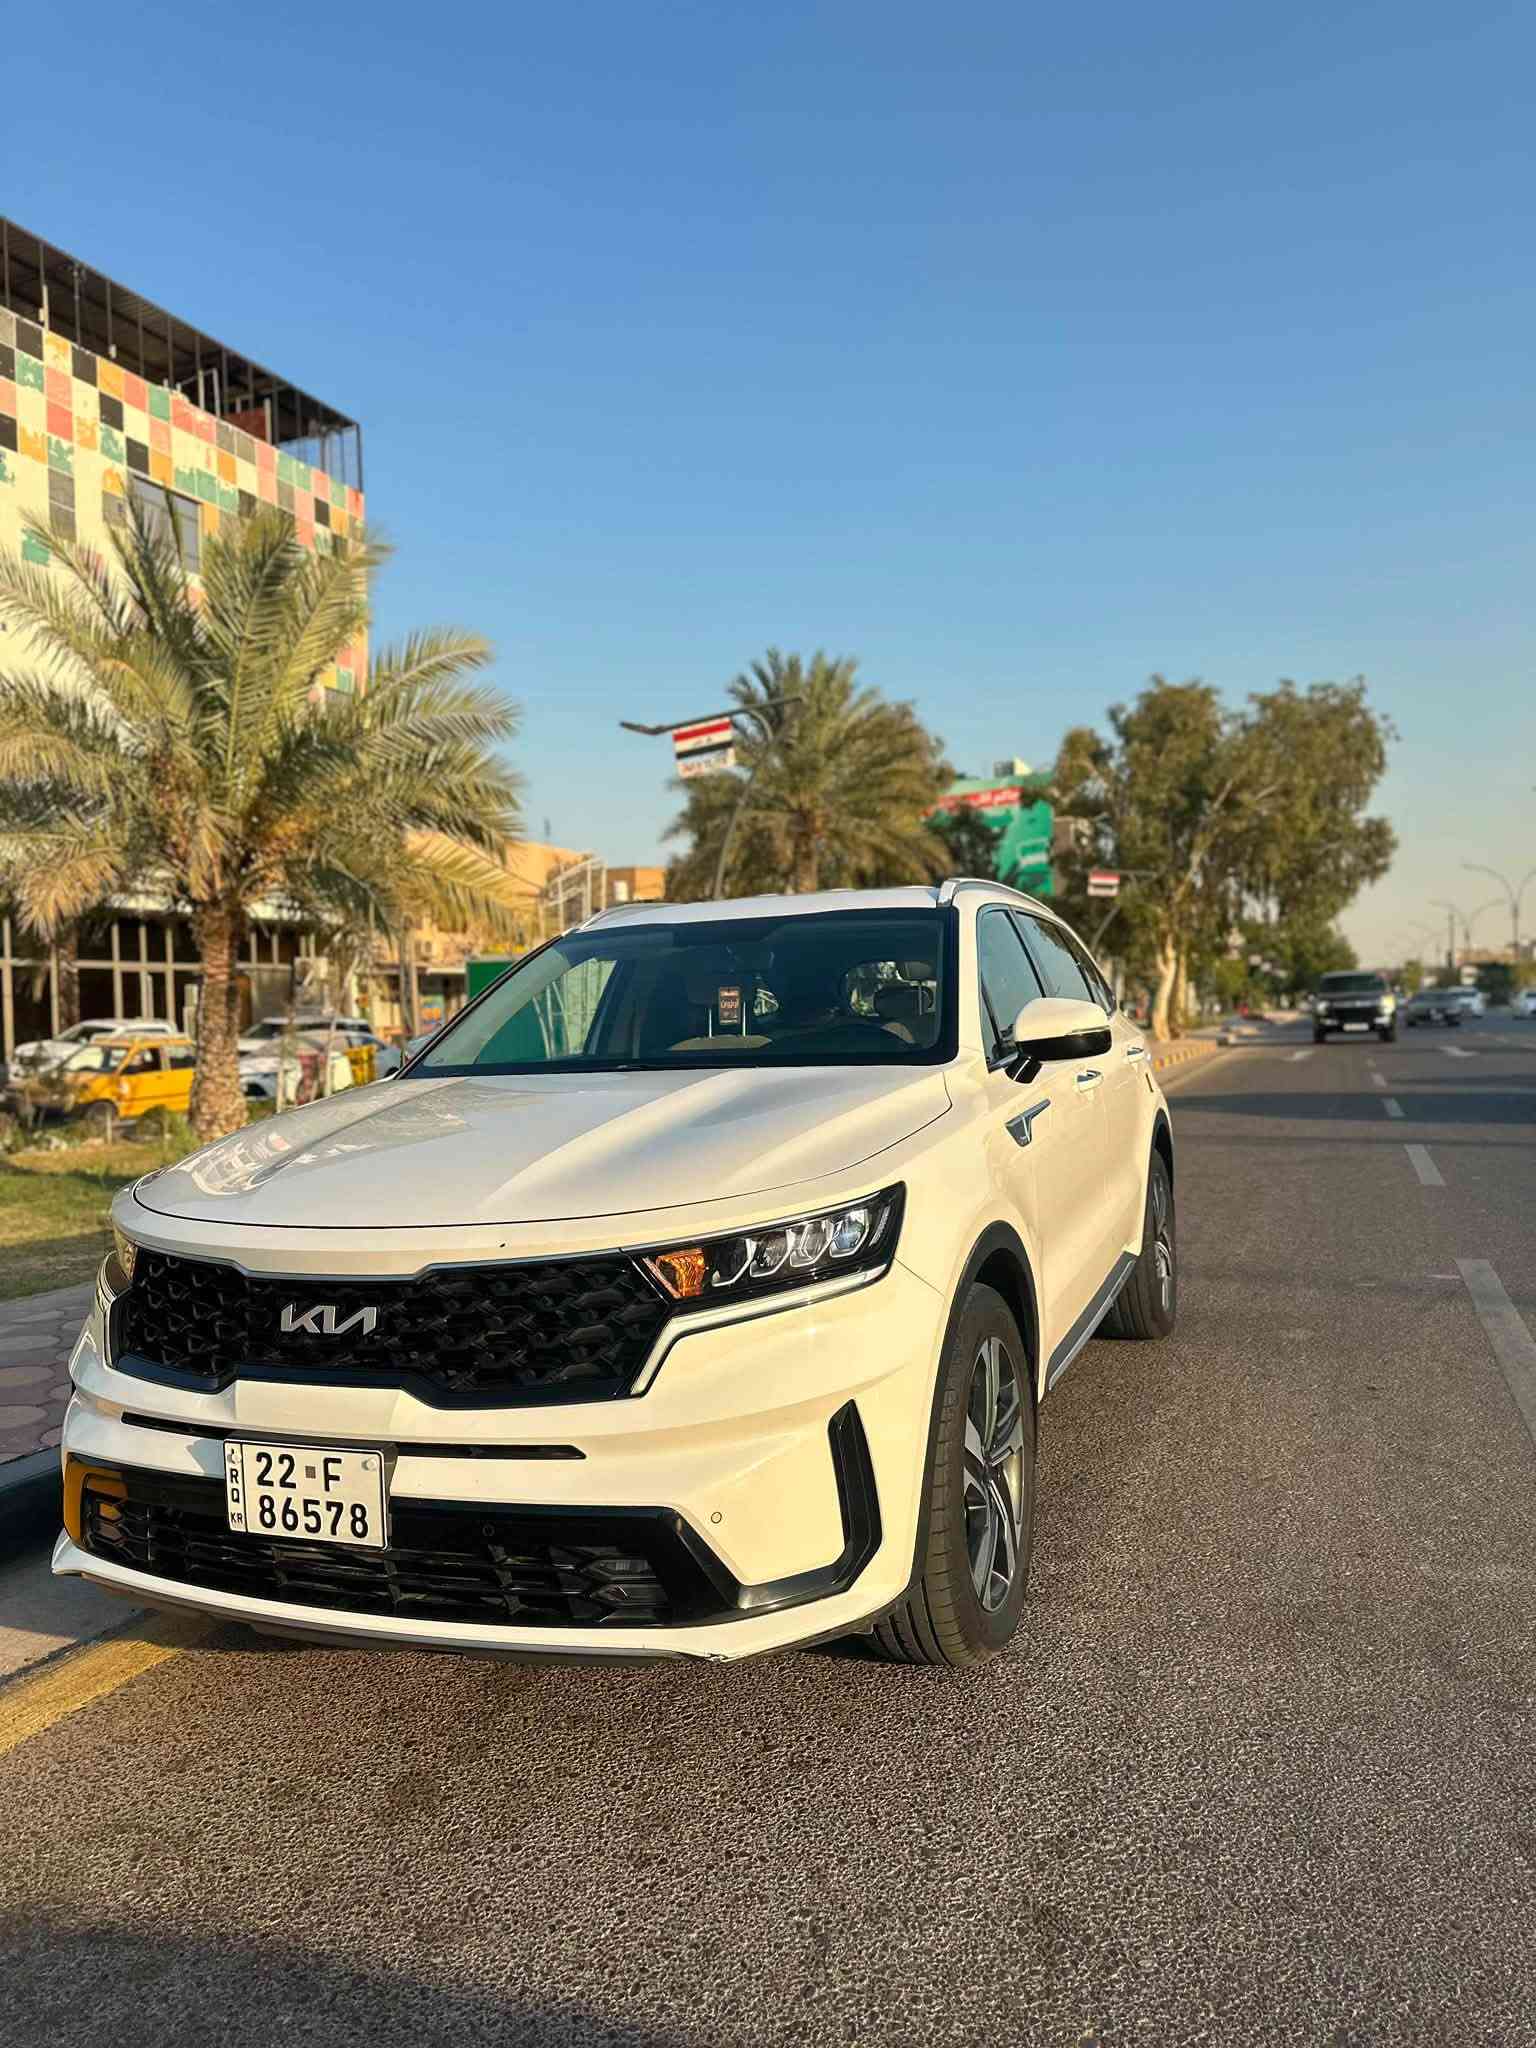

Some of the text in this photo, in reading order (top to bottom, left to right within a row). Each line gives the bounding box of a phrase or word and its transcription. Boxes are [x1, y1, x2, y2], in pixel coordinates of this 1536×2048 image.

[281, 1304, 377, 1336] KIA
[256, 1451, 343, 1492] 22 F
[230, 1511, 243, 1525] KR
[258, 1494, 369, 1539] 86578
